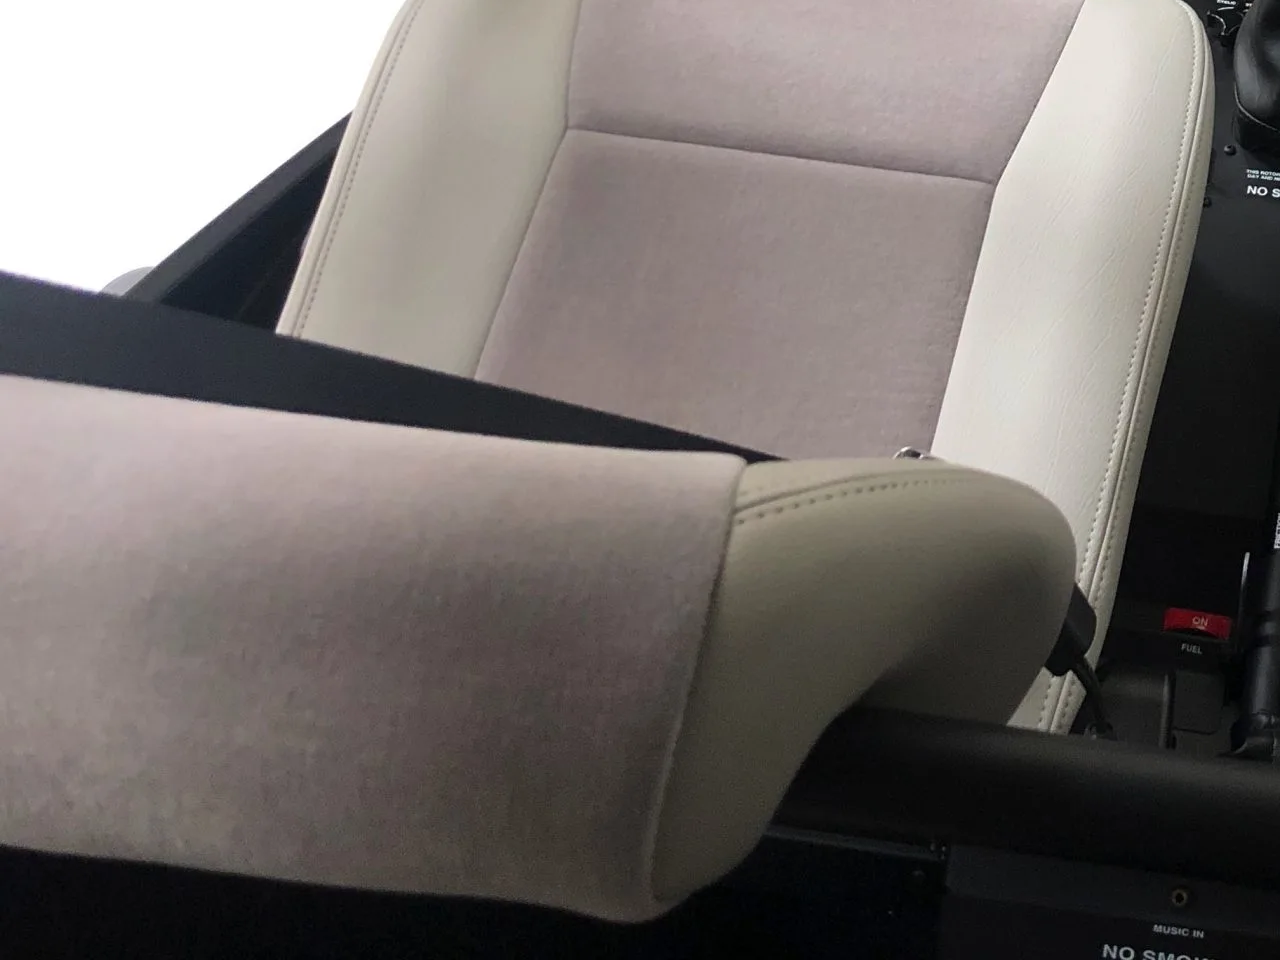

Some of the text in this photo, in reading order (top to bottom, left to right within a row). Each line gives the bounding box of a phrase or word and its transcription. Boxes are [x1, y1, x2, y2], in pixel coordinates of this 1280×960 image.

[1246, 185, 1268, 197] NO
[1191, 615, 1210, 628] ON
[1180, 642, 1204, 656] FUEL
[1153, 923, 1206, 939] MUSIC IN
[1101, 943, 1136, 960] NO
